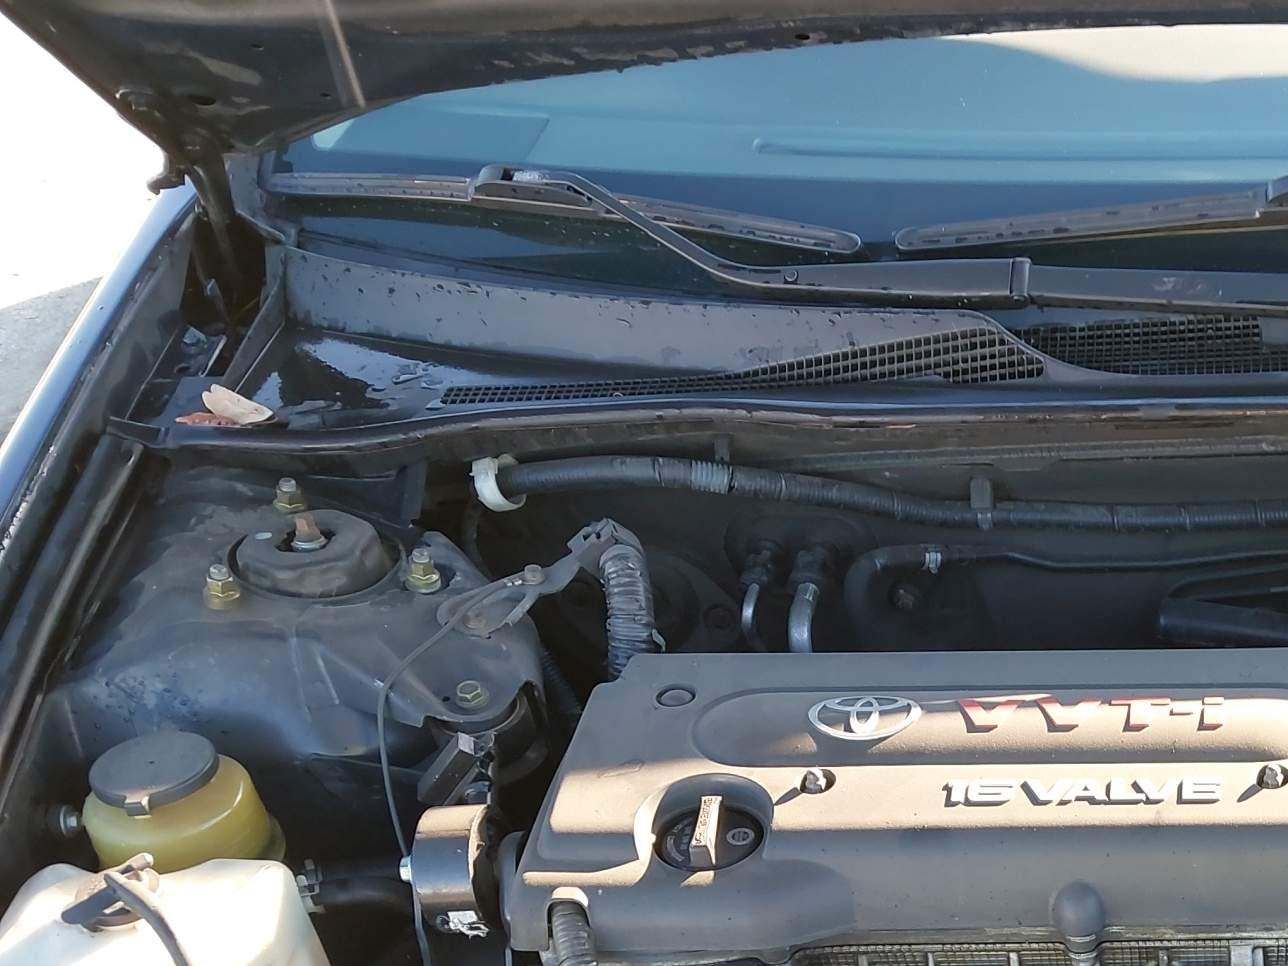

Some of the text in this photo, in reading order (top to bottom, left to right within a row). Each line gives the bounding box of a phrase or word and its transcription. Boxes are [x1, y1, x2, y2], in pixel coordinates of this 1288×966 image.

[956, 695, 1225, 733] VVT-i
[942, 777, 1222, 808] 16 VALVE
